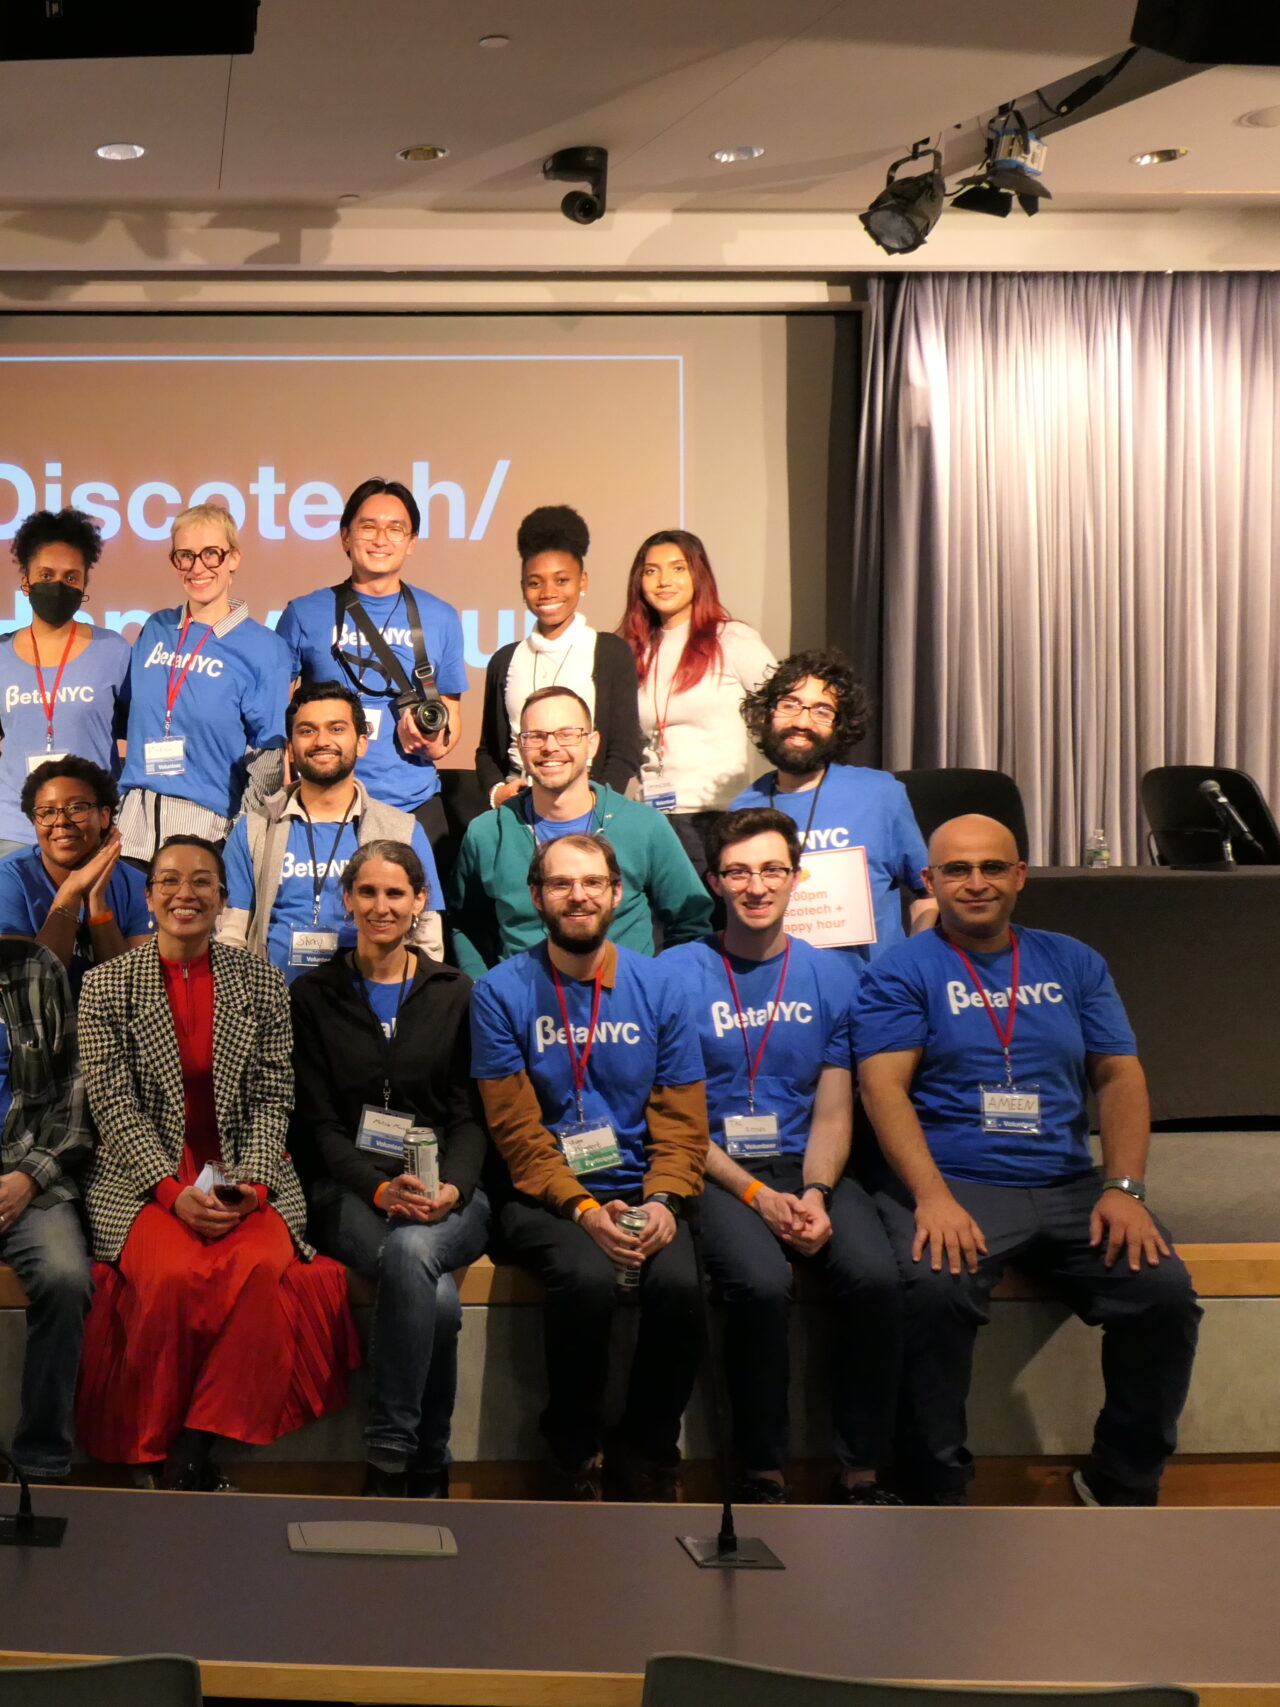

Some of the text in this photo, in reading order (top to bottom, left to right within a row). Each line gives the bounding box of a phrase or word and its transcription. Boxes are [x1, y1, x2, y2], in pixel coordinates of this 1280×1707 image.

[783, 919, 847, 934] appy hour
[987, 1096, 1035, 1111] AMEEN
